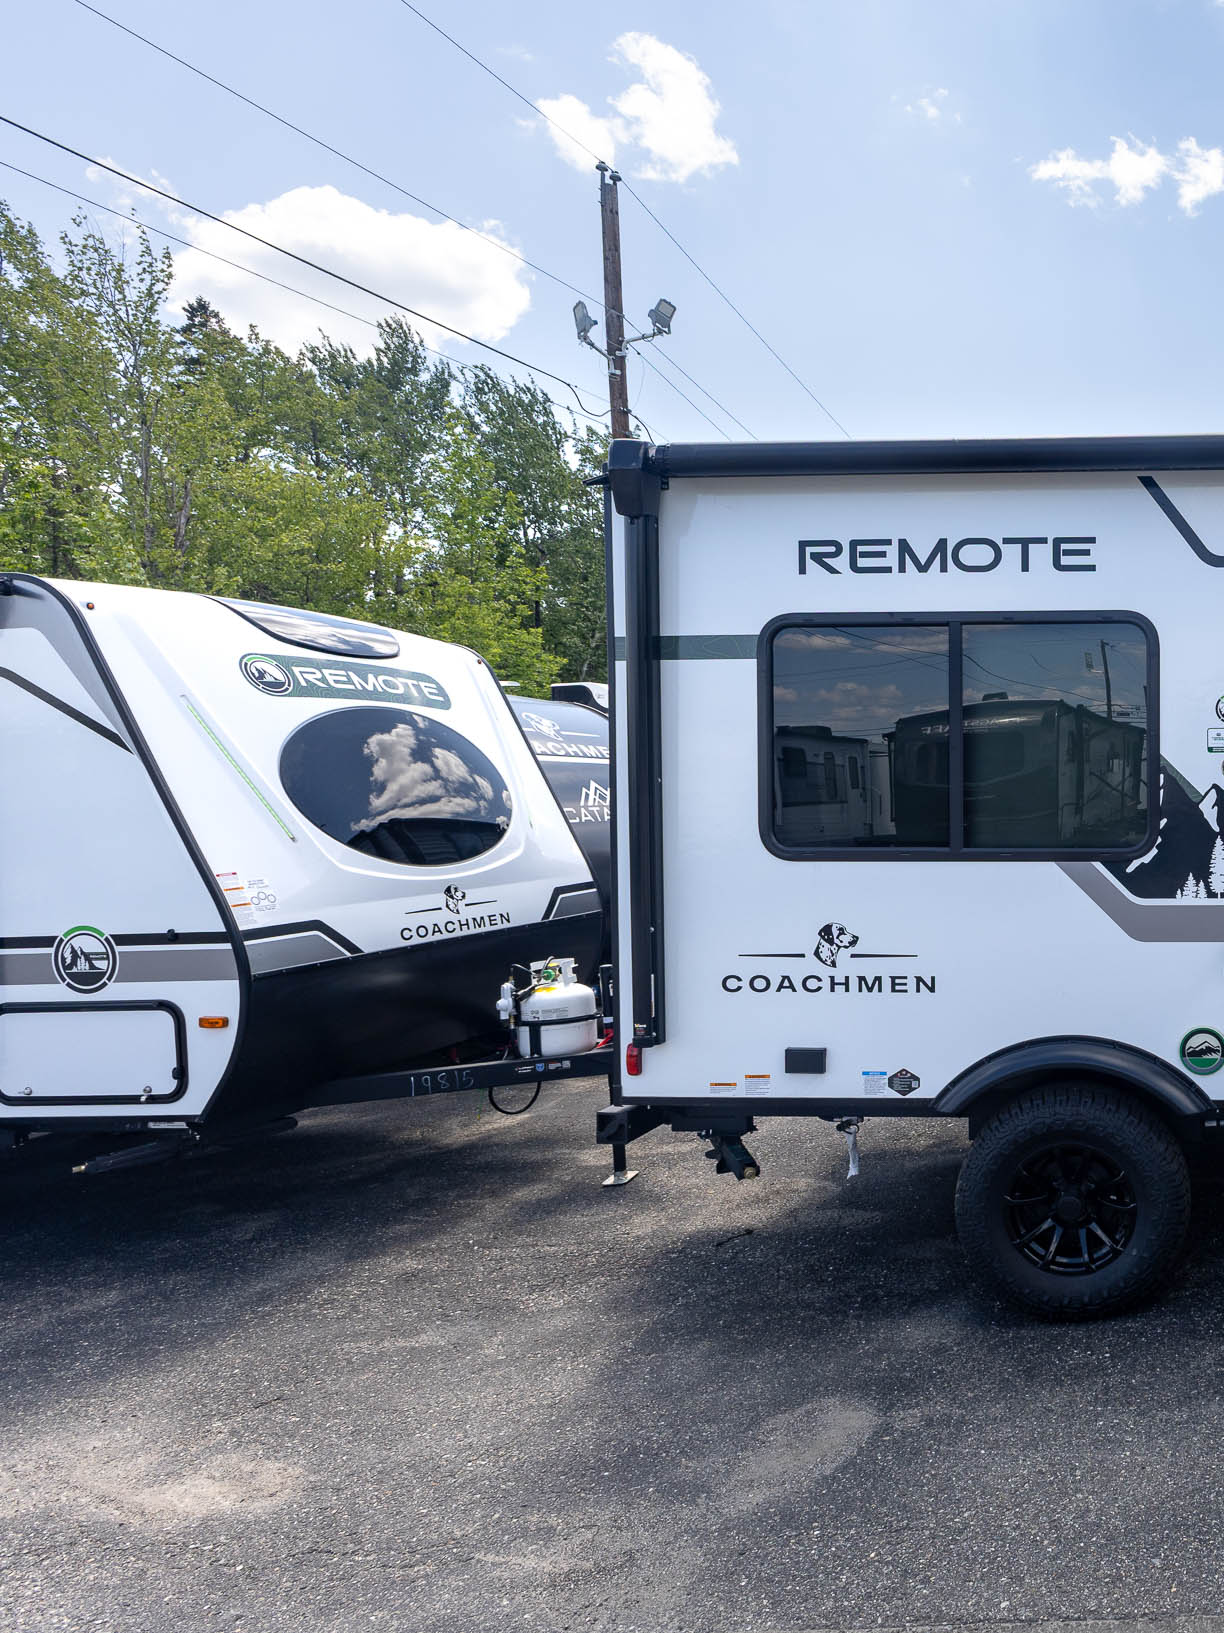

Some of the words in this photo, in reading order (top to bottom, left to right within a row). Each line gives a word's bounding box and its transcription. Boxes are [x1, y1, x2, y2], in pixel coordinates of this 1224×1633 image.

[798, 536, 1096, 575] REMOTE
[291, 666, 445, 701] REMOTE
[530, 740, 610, 758] ACHME
[400, 912, 511, 941] COACHMEN
[721, 974, 936, 993] COACHMEN
